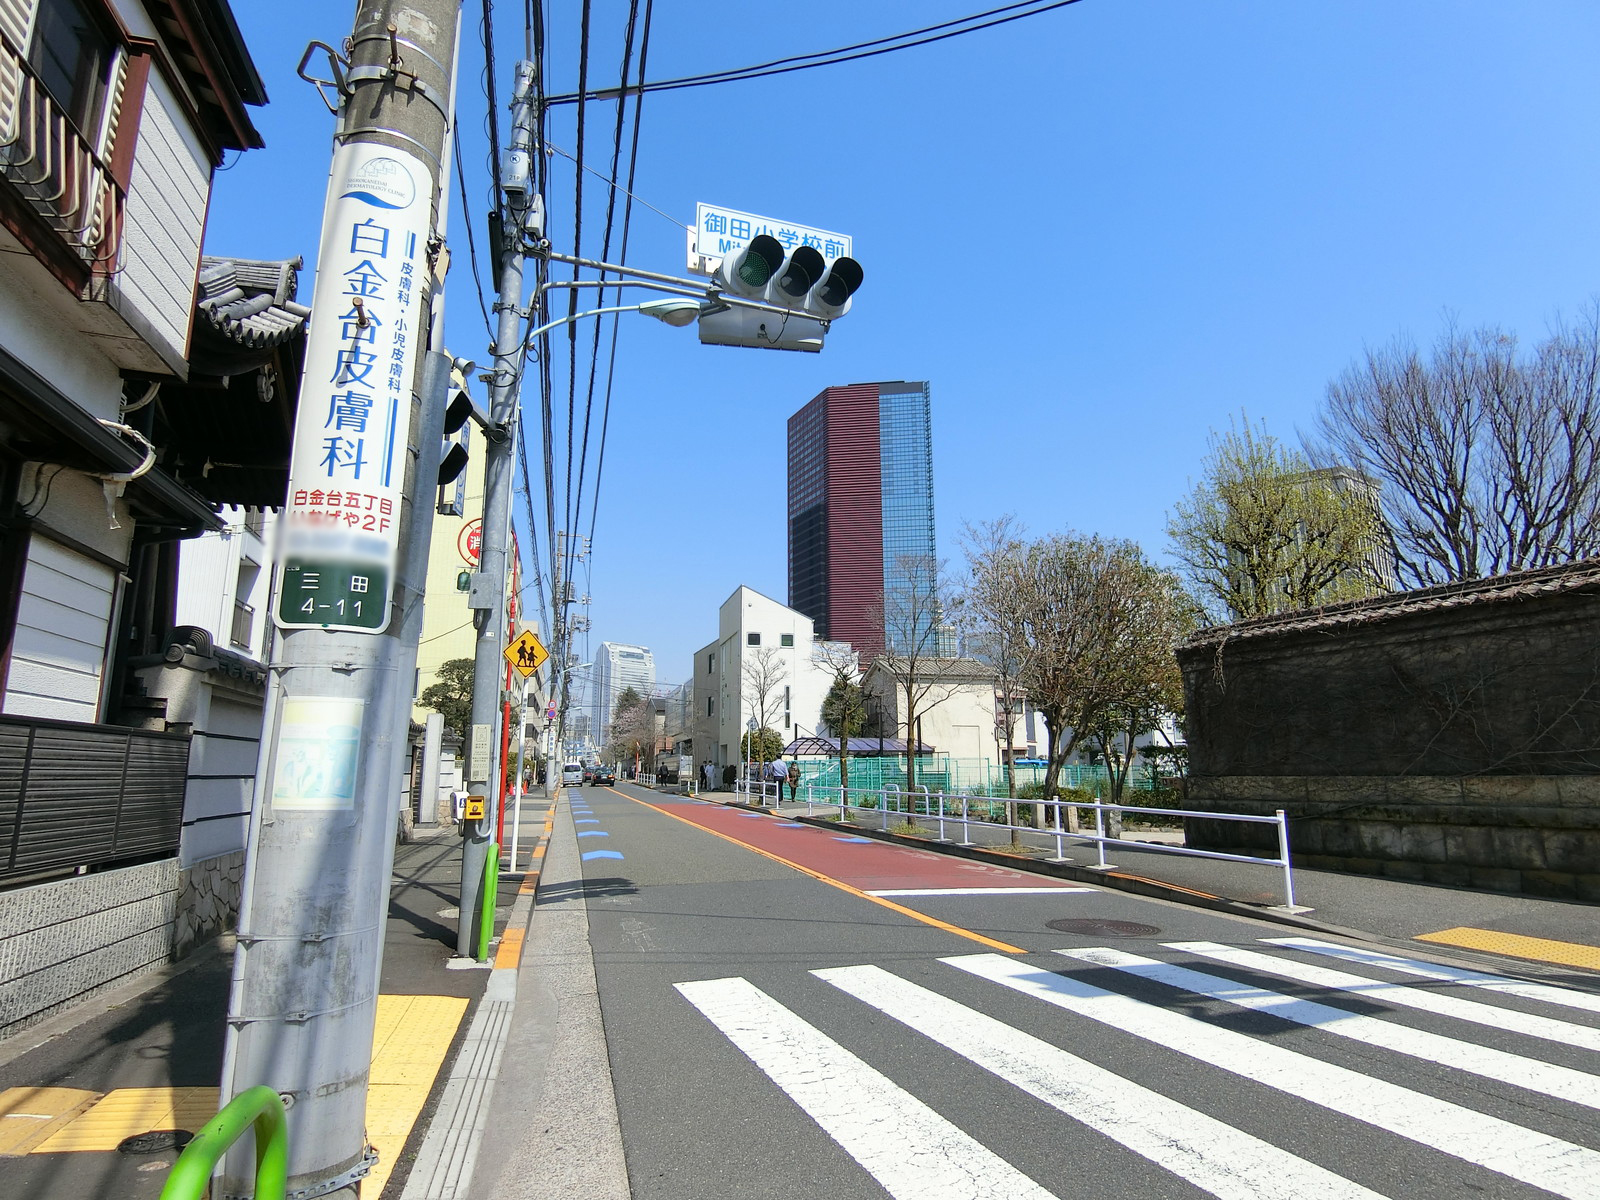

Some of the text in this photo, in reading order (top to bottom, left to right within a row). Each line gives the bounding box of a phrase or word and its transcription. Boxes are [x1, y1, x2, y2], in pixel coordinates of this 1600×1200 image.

[346, 183, 387, 193] DERMATOLOGY
[704, 212, 845, 260] 御田小学校前
[387, 261, 414, 394] 皮膚科・小児皮膚科
[319, 217, 390, 480] 白金台皮膚科
[294, 488, 393, 516] 白金台五丁目
[292, 509, 391, 534] や2F
[300, 572, 370, 594] 三田
[300, 597, 363, 618] 4-11
